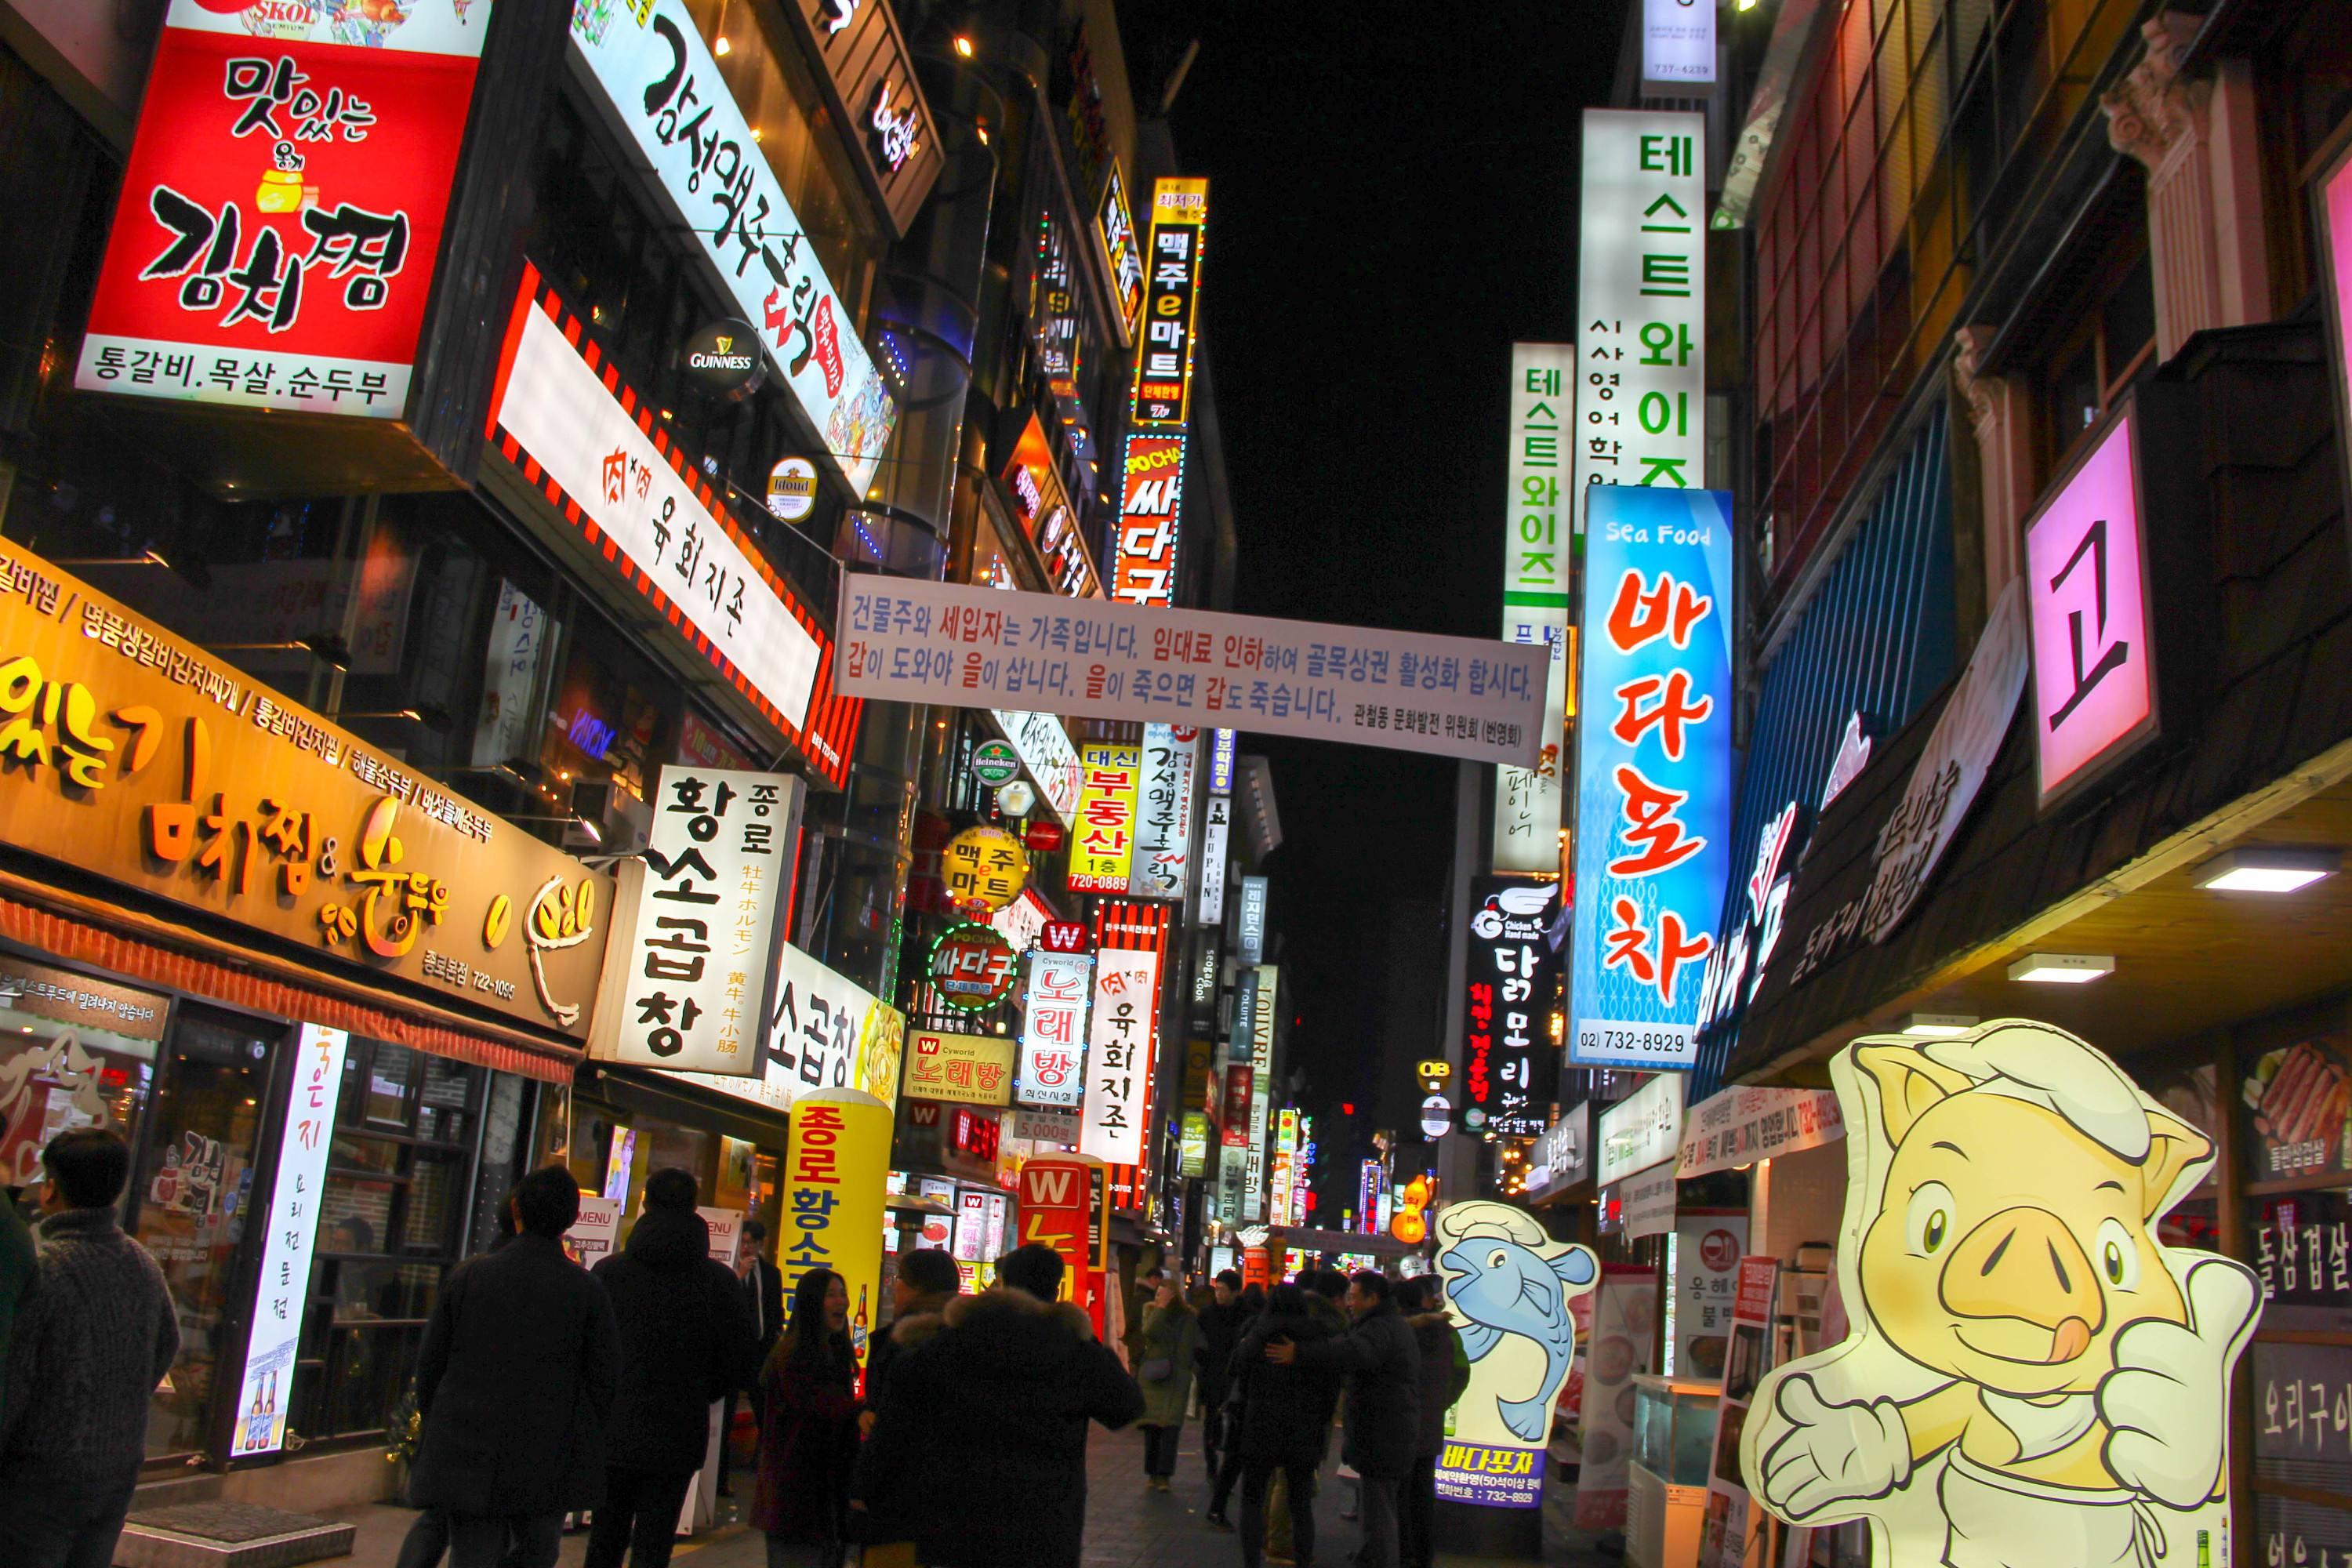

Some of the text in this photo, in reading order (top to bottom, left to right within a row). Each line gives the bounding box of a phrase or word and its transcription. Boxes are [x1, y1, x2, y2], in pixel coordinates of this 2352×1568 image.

[224, 56, 376, 142] 맛있는
[1157, 194, 1204, 209] 최저가
[138, 185, 410, 332] 김치찜
[1146, 232, 1190, 378] 맥주e마트
[690, 354, 751, 370] GUINNESS
[1127, 446, 1181, 475] POCHA
[775, 479, 809, 492] Kloud
[1519, 368, 1561, 585] 테스트와이즈
[1119, 475, 1181, 606] 싸다구
[1606, 521, 1711, 546] Sea Food
[652, 495, 749, 639] 육회지존
[853, 594, 1532, 702] 건물주와 세입자는 가족입니다. 임대료 인하하여 골목상권 활성화 합시다.
[848, 641, 1342, 724] 갑이 도와야 을이 삽니다. 을이 죽으면 갑도 죽습니다.
[81, 601, 240, 714] 명품생갈비김치찌개
[253, 695, 340, 768] 통갈비김치찜
[350, 749, 412, 799] 해물순두부
[421, 786, 494, 844] 버섯들깨순두부
[1445, 715, 1479, 741] 위원회
[975, 757, 1018, 771] Heineken
[1086, 750, 1138, 768] 대신
[1605, 567, 1715, 1008] 바다포차
[739, 782, 780, 855] 종로
[1080, 769, 1134, 858] 부동산
[1505, 769, 1534, 838] 페인어
[113, 703, 315, 898] 김치찜
[320, 836, 339, 877] &
[351, 795, 451, 957] 순두부
[956, 844, 1014, 872] 맥주
[978, 865, 992, 877] e
[1087, 857, 1118, 873] 1층
[1203, 828, 1215, 898] LUPIN
[952, 871, 1011, 898] 마트
[1071, 873, 1129, 891] 720-0889
[636, 775, 738, 1058] 황소곱창
[1504, 920, 1533, 931] Chicken
[953, 932, 996, 945] POCHA
[1049, 924, 1081, 949] W
[1504, 931, 1541, 941] Hand made
[421, 949, 517, 1001] 종로본점 722-1095
[933, 947, 1014, 987] 싸다구
[1042, 957, 1074, 967] Cyworld
[78, 993, 117, 1013] 밀려나지
[1494, 944, 1541, 1090] 닭모리
[1033, 967, 1082, 1088] 노래방
[1253, 987, 1272, 1069] LOUVRE
[1580, 1029, 1685, 1054] 02) 732-8929
[920, 1040, 938, 1054] W
[942, 1047, 975, 1056] Cyworld
[912, 1056, 1007, 1091] 노래방
[1098, 1002, 1138, 1140] 육회지존
[1418, 1062, 1450, 1077] OB
[1025, 1088, 1072, 1102] 최신시설
[793, 1105, 846, 1185] 종로
[967, 1197, 981, 1207] W
[1027, 1171, 1072, 1205] W
[578, 1211, 612, 1225] MENU
[273, 1173, 309, 1323] 요리전문점
[1441, 1444, 1534, 1475] 바다포차
[1436, 1483, 1534, 1504] 전화번호 732-8929
